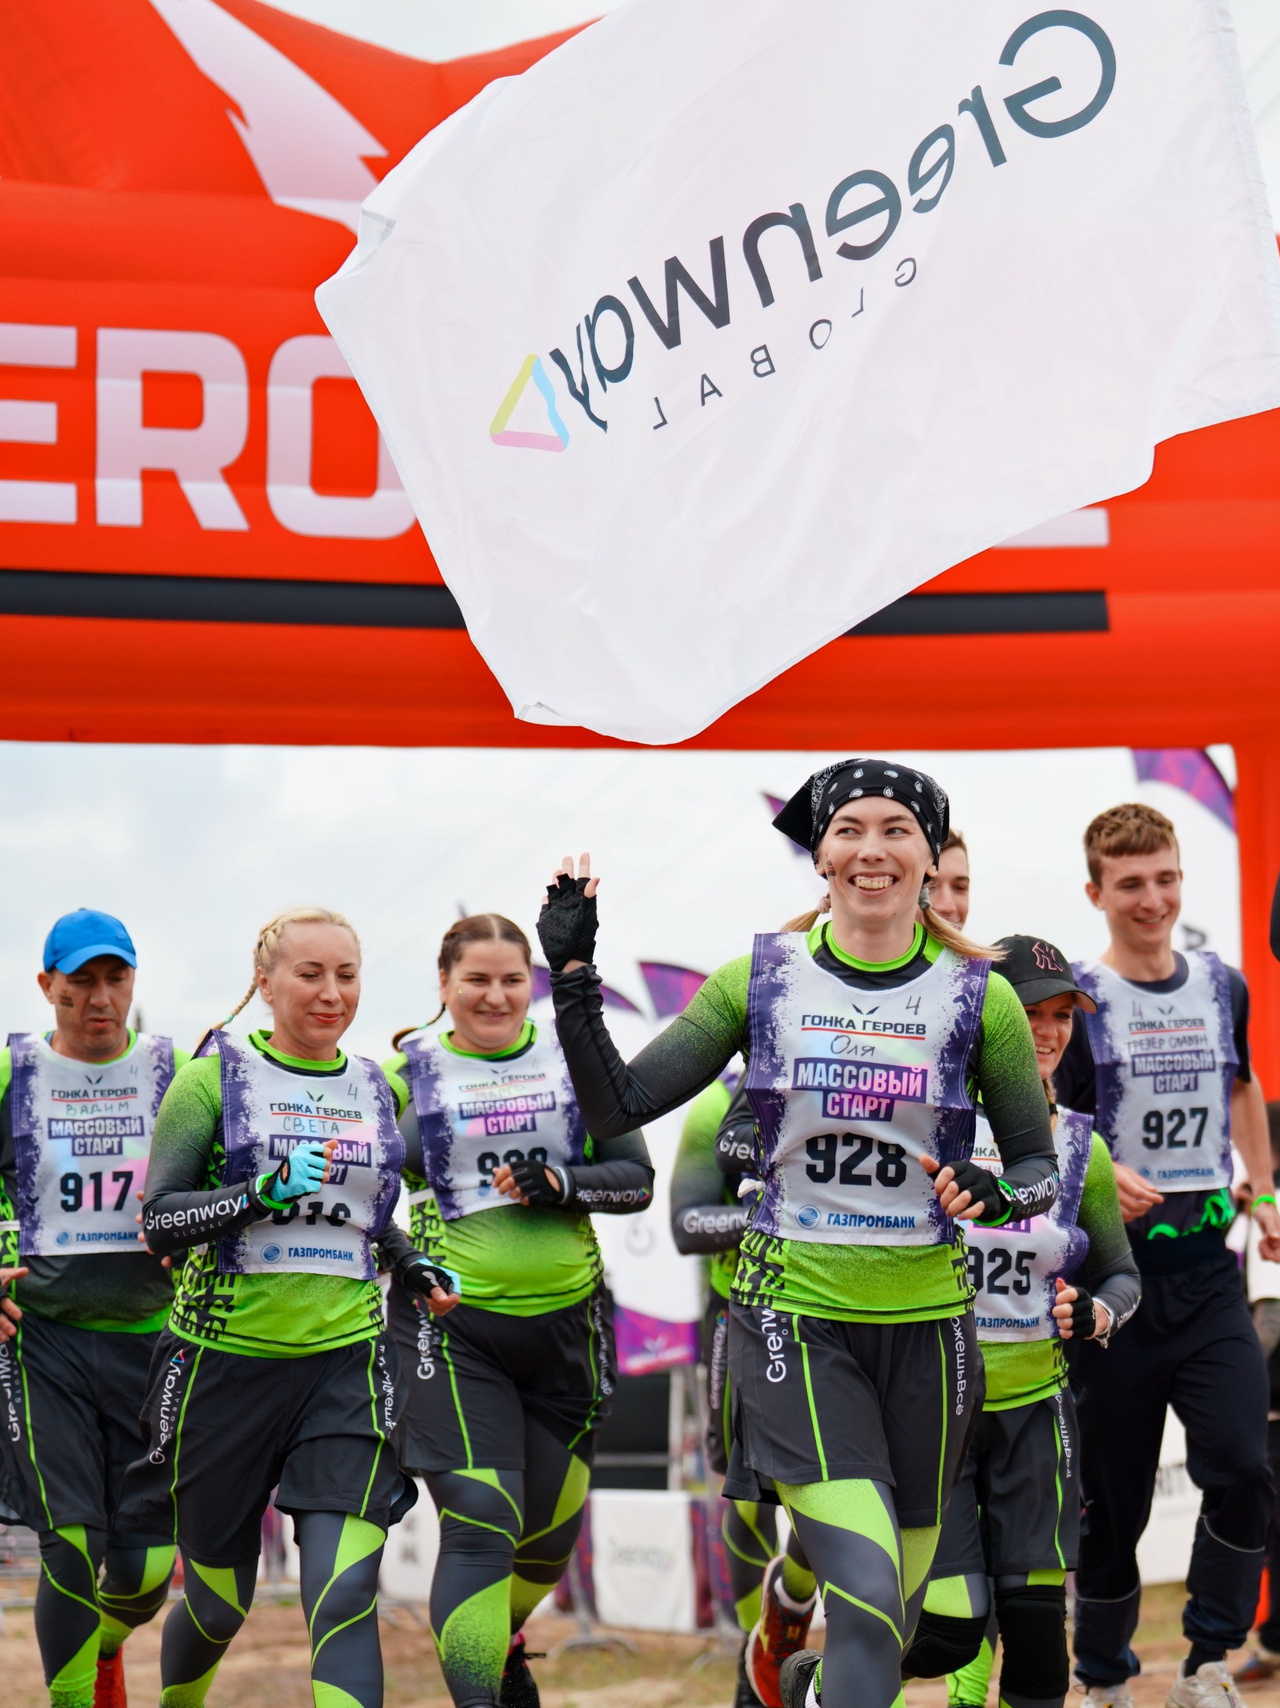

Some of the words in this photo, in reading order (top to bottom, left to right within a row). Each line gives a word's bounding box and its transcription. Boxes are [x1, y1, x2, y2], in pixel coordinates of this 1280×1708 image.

[905, 995, 921, 1015] 4
[801, 1014, 857, 1030] ГОНКА
[862, 1020, 926, 1036] ГЕРОЕВ
[1128, 1021, 1165, 1031] ГОНКА
[1168, 1019, 1205, 1029] ГЕРОЕВ
[831, 1035, 876, 1058] Оля
[1135, 1050, 1214, 1074] МАССОВЫЙ
[459, 1080, 498, 1091] ГОНКА
[501, 1073, 546, 1086] ГЕРОЕВ
[797, 1062, 924, 1098] МАССОВЫЙ
[1156, 1074, 1197, 1093] СТАРТ
[52, 1089, 89, 1099] ГОНКА
[93, 1087, 138, 1098] ГЕРОЕВ
[66, 1101, 130, 1116] ВАДИМ
[269, 1103, 313, 1115] ГОНКА
[316, 1107, 363, 1119] ГЕРОЕВ
[462, 1092, 554, 1117] МАССОВЫЙ
[827, 1094, 891, 1119] СТАРТ
[51, 1116, 142, 1137] МАССОВЫЙ
[283, 1117, 340, 1134] СВЕТА
[486, 1114, 533, 1134] СТАРТ
[1142, 1107, 1208, 1150] 927
[74, 1137, 120, 1155] СТАРТ
[273, 1137, 368, 1163] МАВЫЙ
[805, 1132, 907, 1188] 928
[60, 1171, 134, 1213] 917
[145, 1195, 244, 1231] Greenway
[827, 1213, 916, 1229] ГАЗПРОМБАНК
[173, 1221, 223, 1238] GLOBAL
[288, 1247, 354, 1262] ГАЗПРОМБАНК
[976, 1316, 1041, 1328] ГАЗПРОМБАНК
